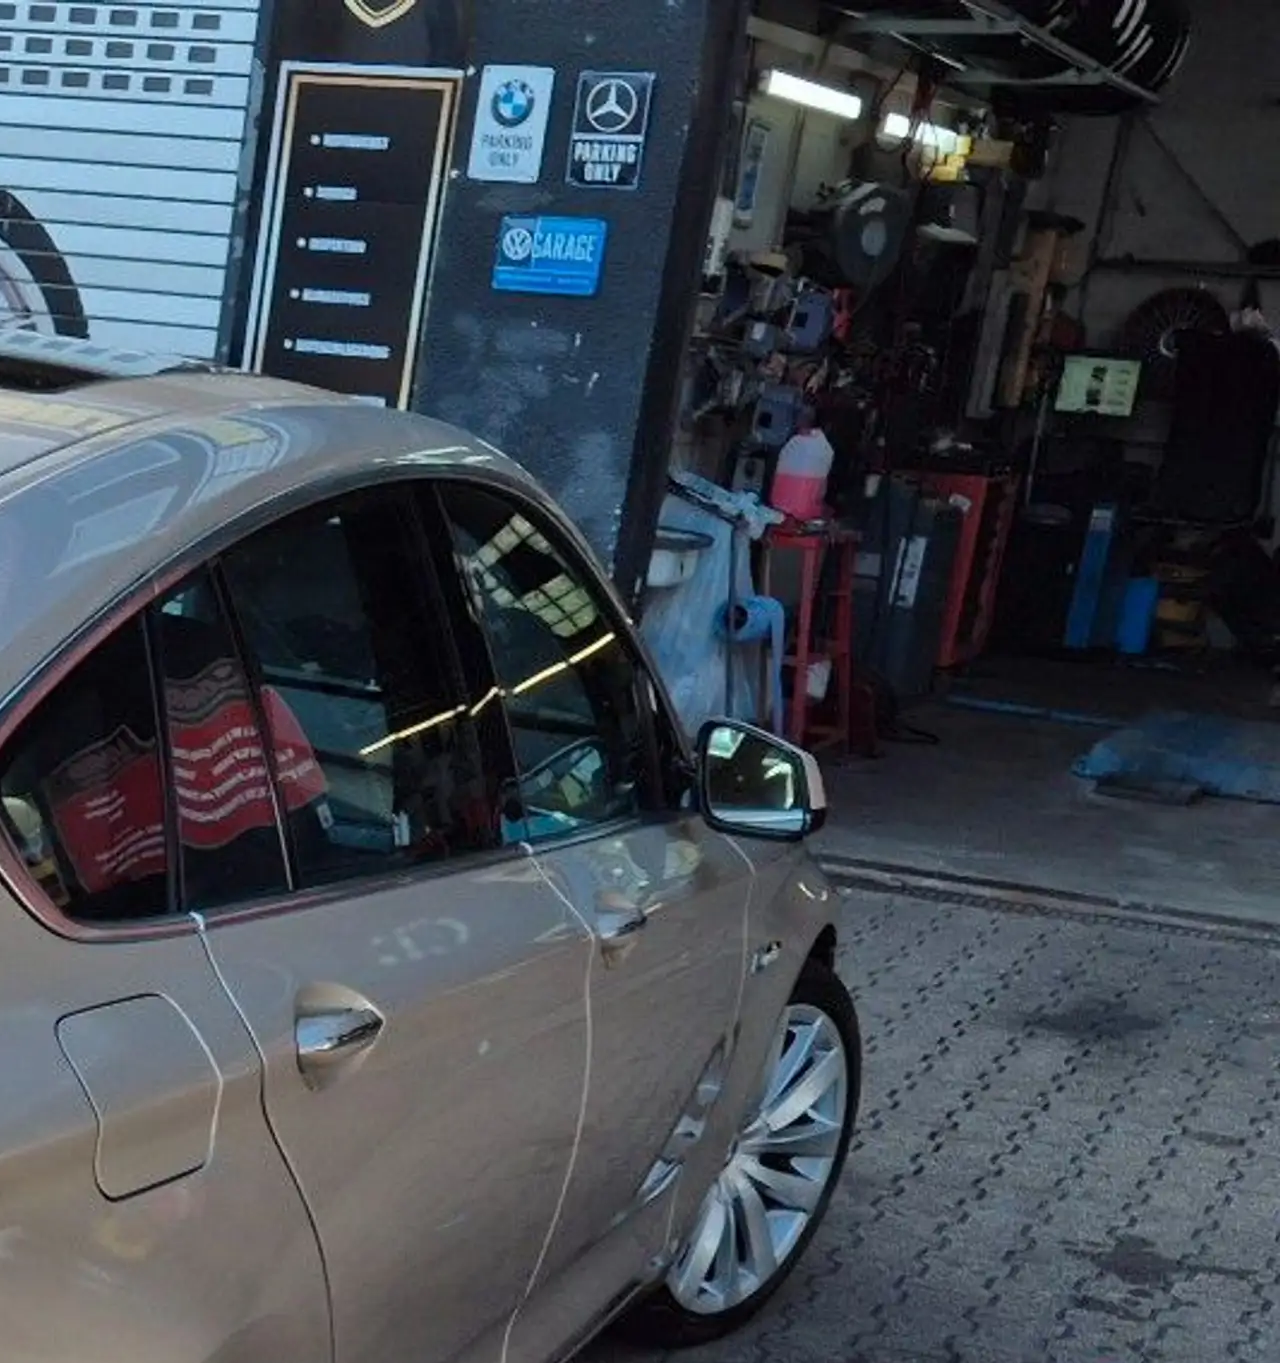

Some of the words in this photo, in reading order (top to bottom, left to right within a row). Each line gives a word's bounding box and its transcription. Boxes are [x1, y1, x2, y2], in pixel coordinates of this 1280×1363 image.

[481, 134, 533, 150] PARKING
[573, 141, 638, 164] PARKING
[583, 163, 622, 183] ONLY
[532, 232, 595, 263] GARAGE
